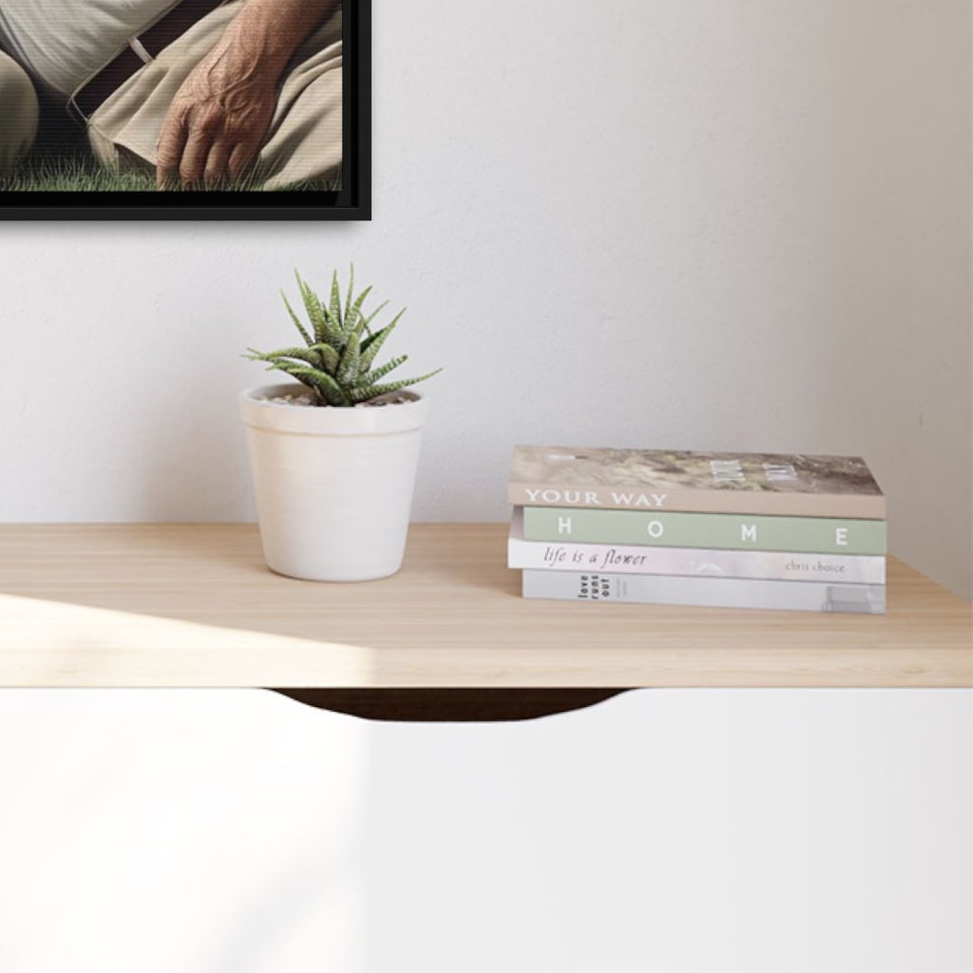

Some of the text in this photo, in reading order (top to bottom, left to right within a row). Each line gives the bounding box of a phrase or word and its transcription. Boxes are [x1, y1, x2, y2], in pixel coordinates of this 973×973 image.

[525, 489, 667, 506] YOUR WAY
[543, 546, 648, 569] life is a flower
[785, 560, 809, 571] chris
[578, 575, 588, 599] love
[591, 575, 599, 599] runs
[601, 578, 610, 597] out
